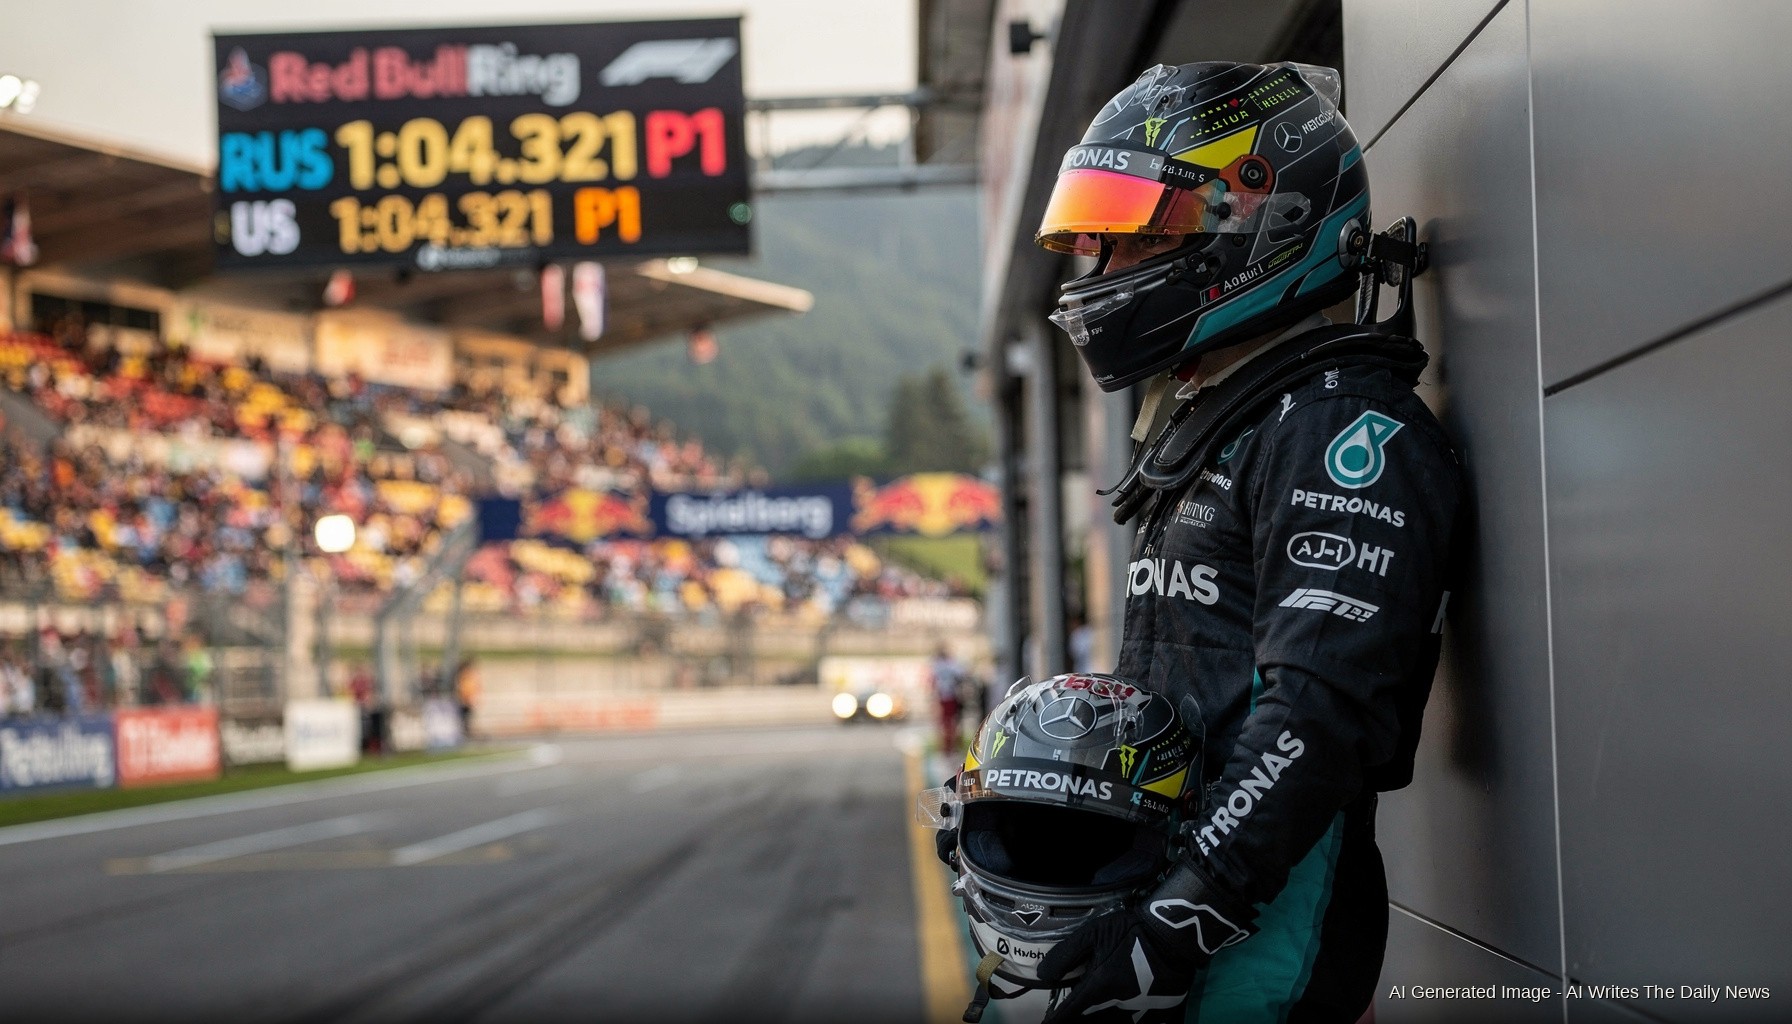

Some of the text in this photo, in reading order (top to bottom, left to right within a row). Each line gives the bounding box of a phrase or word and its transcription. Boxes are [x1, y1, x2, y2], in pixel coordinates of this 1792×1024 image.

[221, 107, 727, 192] RUS 1:04.321 P1
[230, 186, 642, 257] US 1:04.321 P1
[1291, 488, 1406, 528] PETRONAS
[1356, 542, 1395, 577] HT
[985, 769, 1113, 801] PETRONAS
